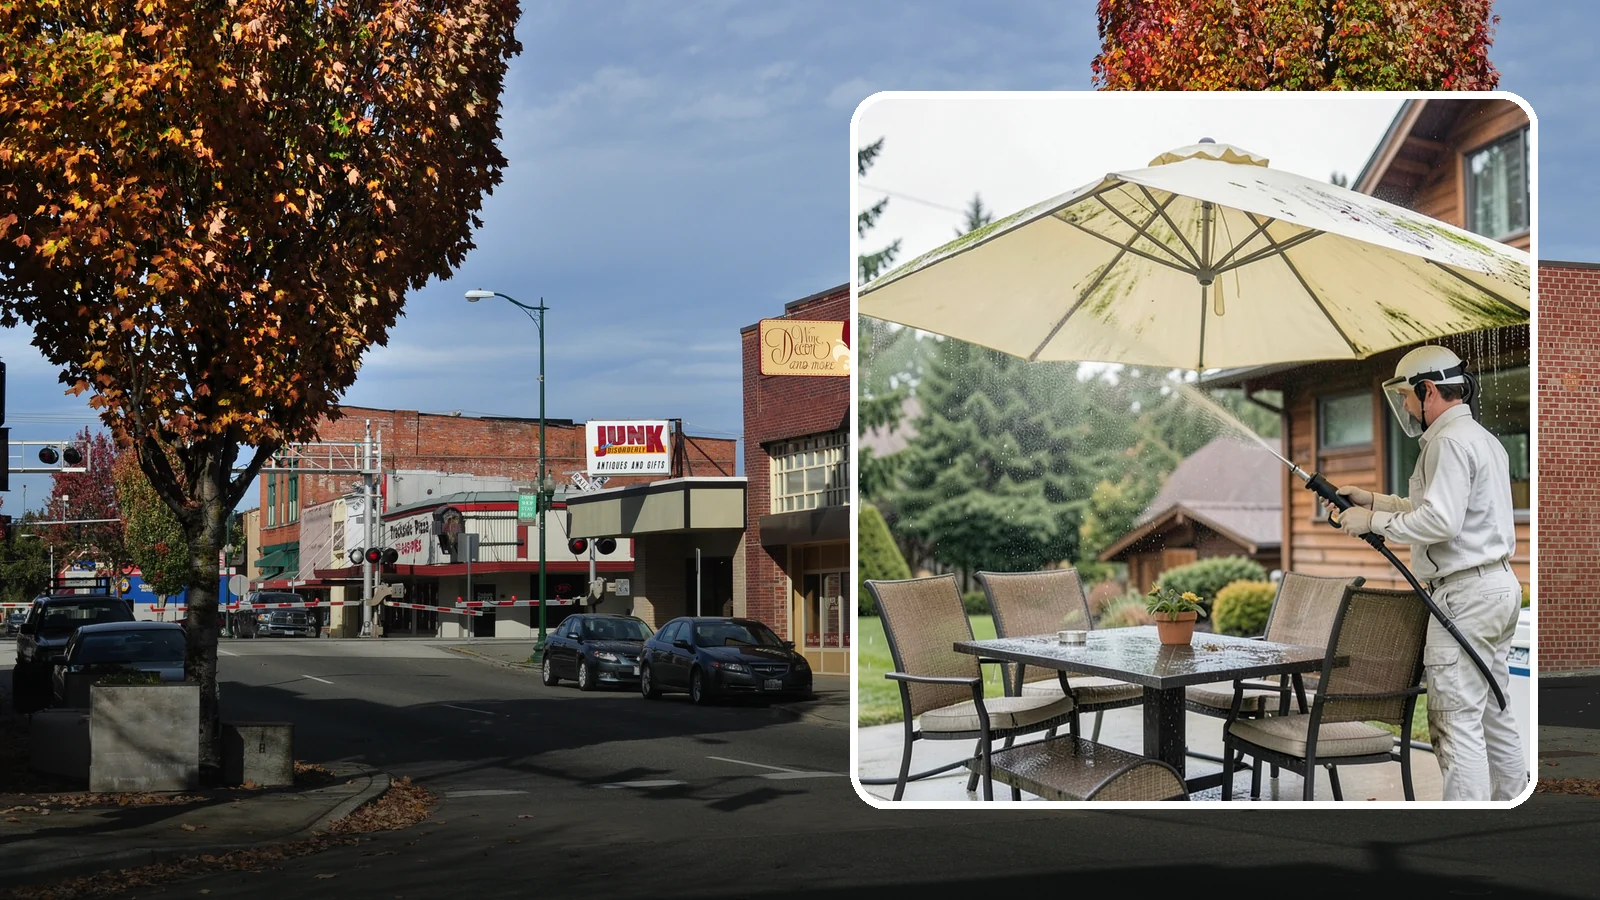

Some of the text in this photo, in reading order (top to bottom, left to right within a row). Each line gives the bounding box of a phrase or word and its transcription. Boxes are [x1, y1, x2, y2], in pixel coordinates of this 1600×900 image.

[595, 425, 664, 457] JUNK
[607, 446, 646, 454] DISORDERLY
[597, 460, 665, 470] ANTIQUES AND GIFTS
[414, 519, 429, 535] Pizza
